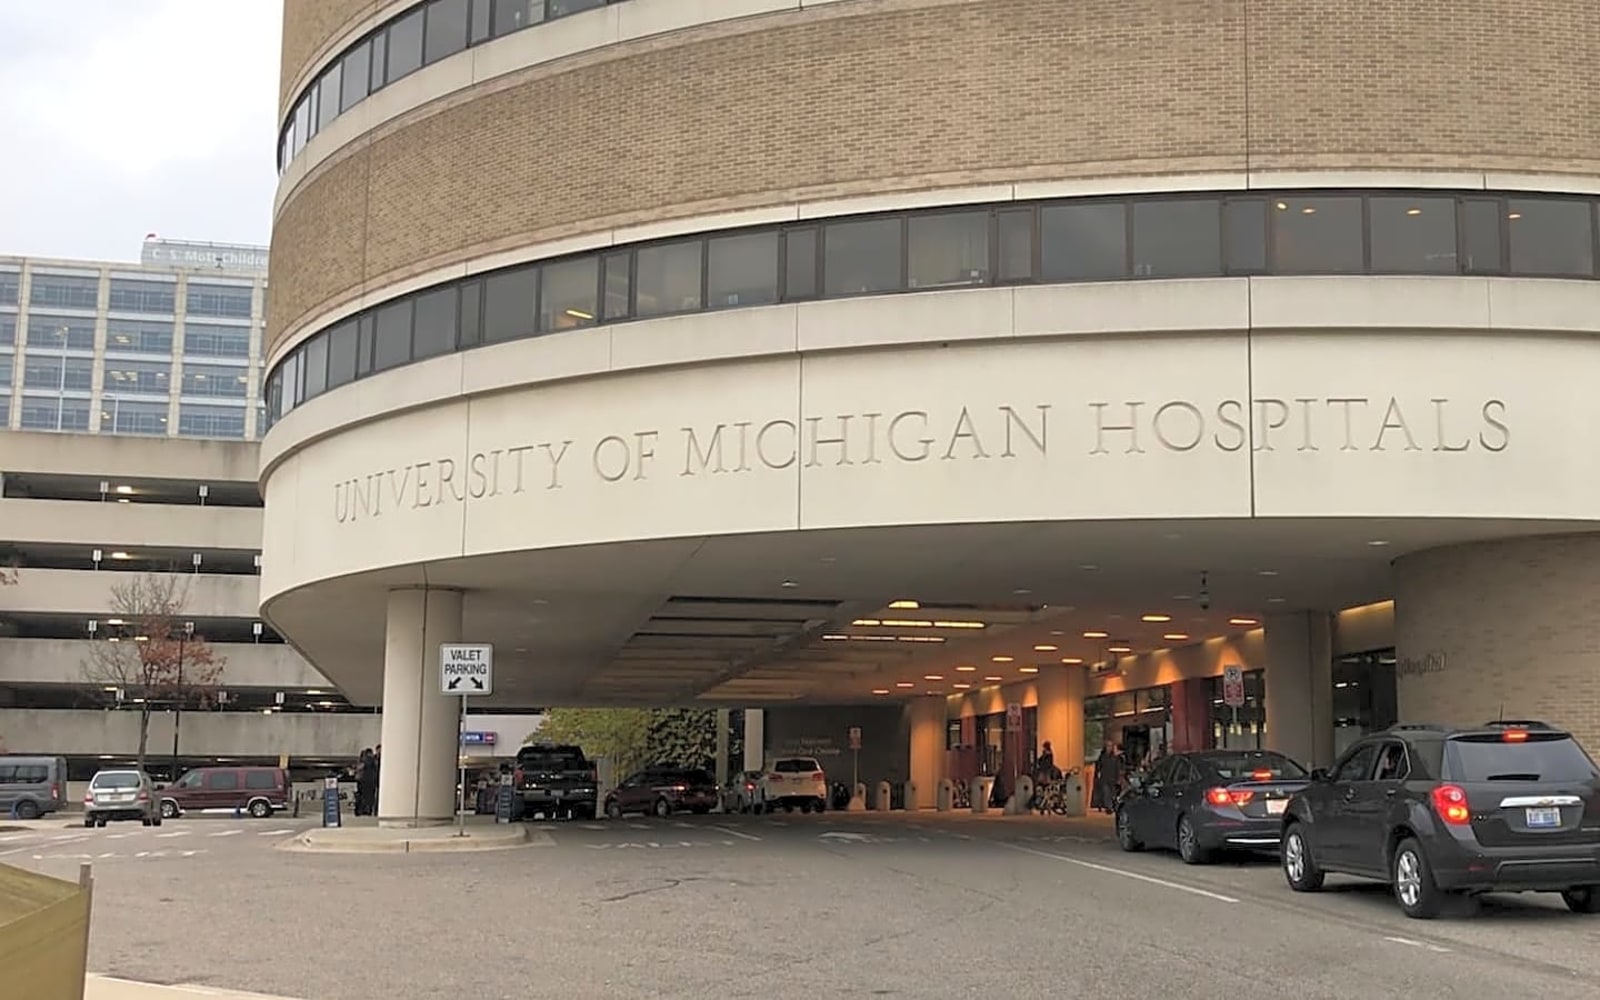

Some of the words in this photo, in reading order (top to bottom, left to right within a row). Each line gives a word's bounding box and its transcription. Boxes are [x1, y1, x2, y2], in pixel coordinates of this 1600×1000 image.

[184, 251, 217, 262] Mott
[334, 440, 573, 523] UNIVERSITY
[593, 430, 659, 482] OF
[680, 404, 1051, 475] MICHIGAN
[1088, 396, 1510, 455] HOSPITALS
[450, 650, 482, 660] VALET
[445, 663, 487, 675] PARKING
